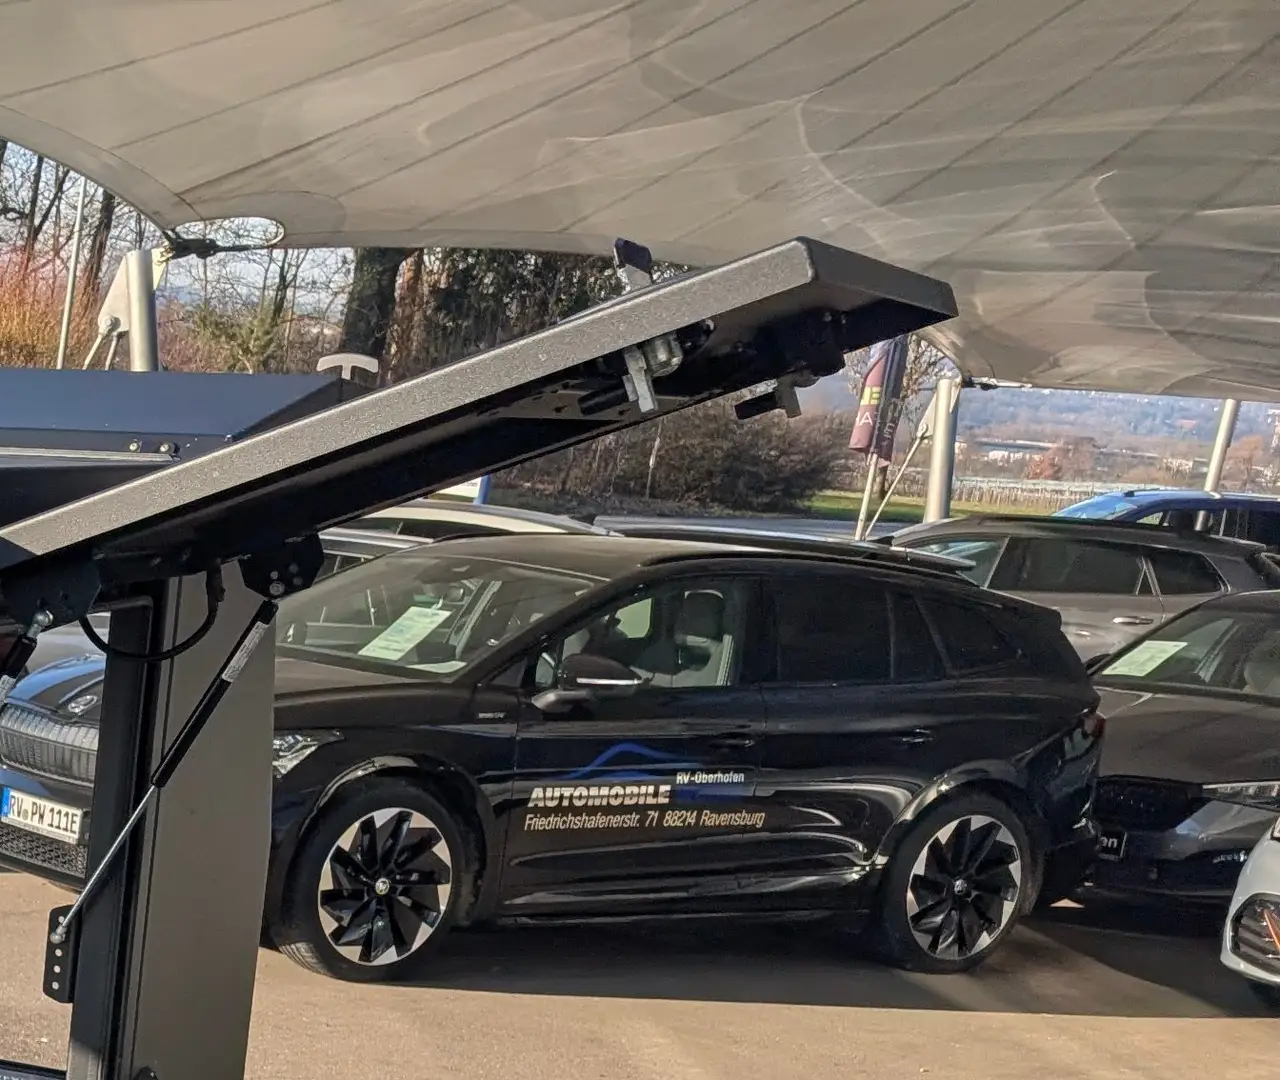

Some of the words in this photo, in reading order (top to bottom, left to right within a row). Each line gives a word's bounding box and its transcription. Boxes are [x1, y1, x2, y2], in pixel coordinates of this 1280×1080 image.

[676, 771, 745, 785] RV-Oberhofen
[527, 784, 671, 808] AUTOMOBILE
[47, 808, 79, 834] 111E
[524, 811, 640, 831] Friedrichshafenerstr.
[645, 811, 659, 827] 71
[663, 810, 698, 827] 88214
[700, 809, 766, 829] Ravensburg
